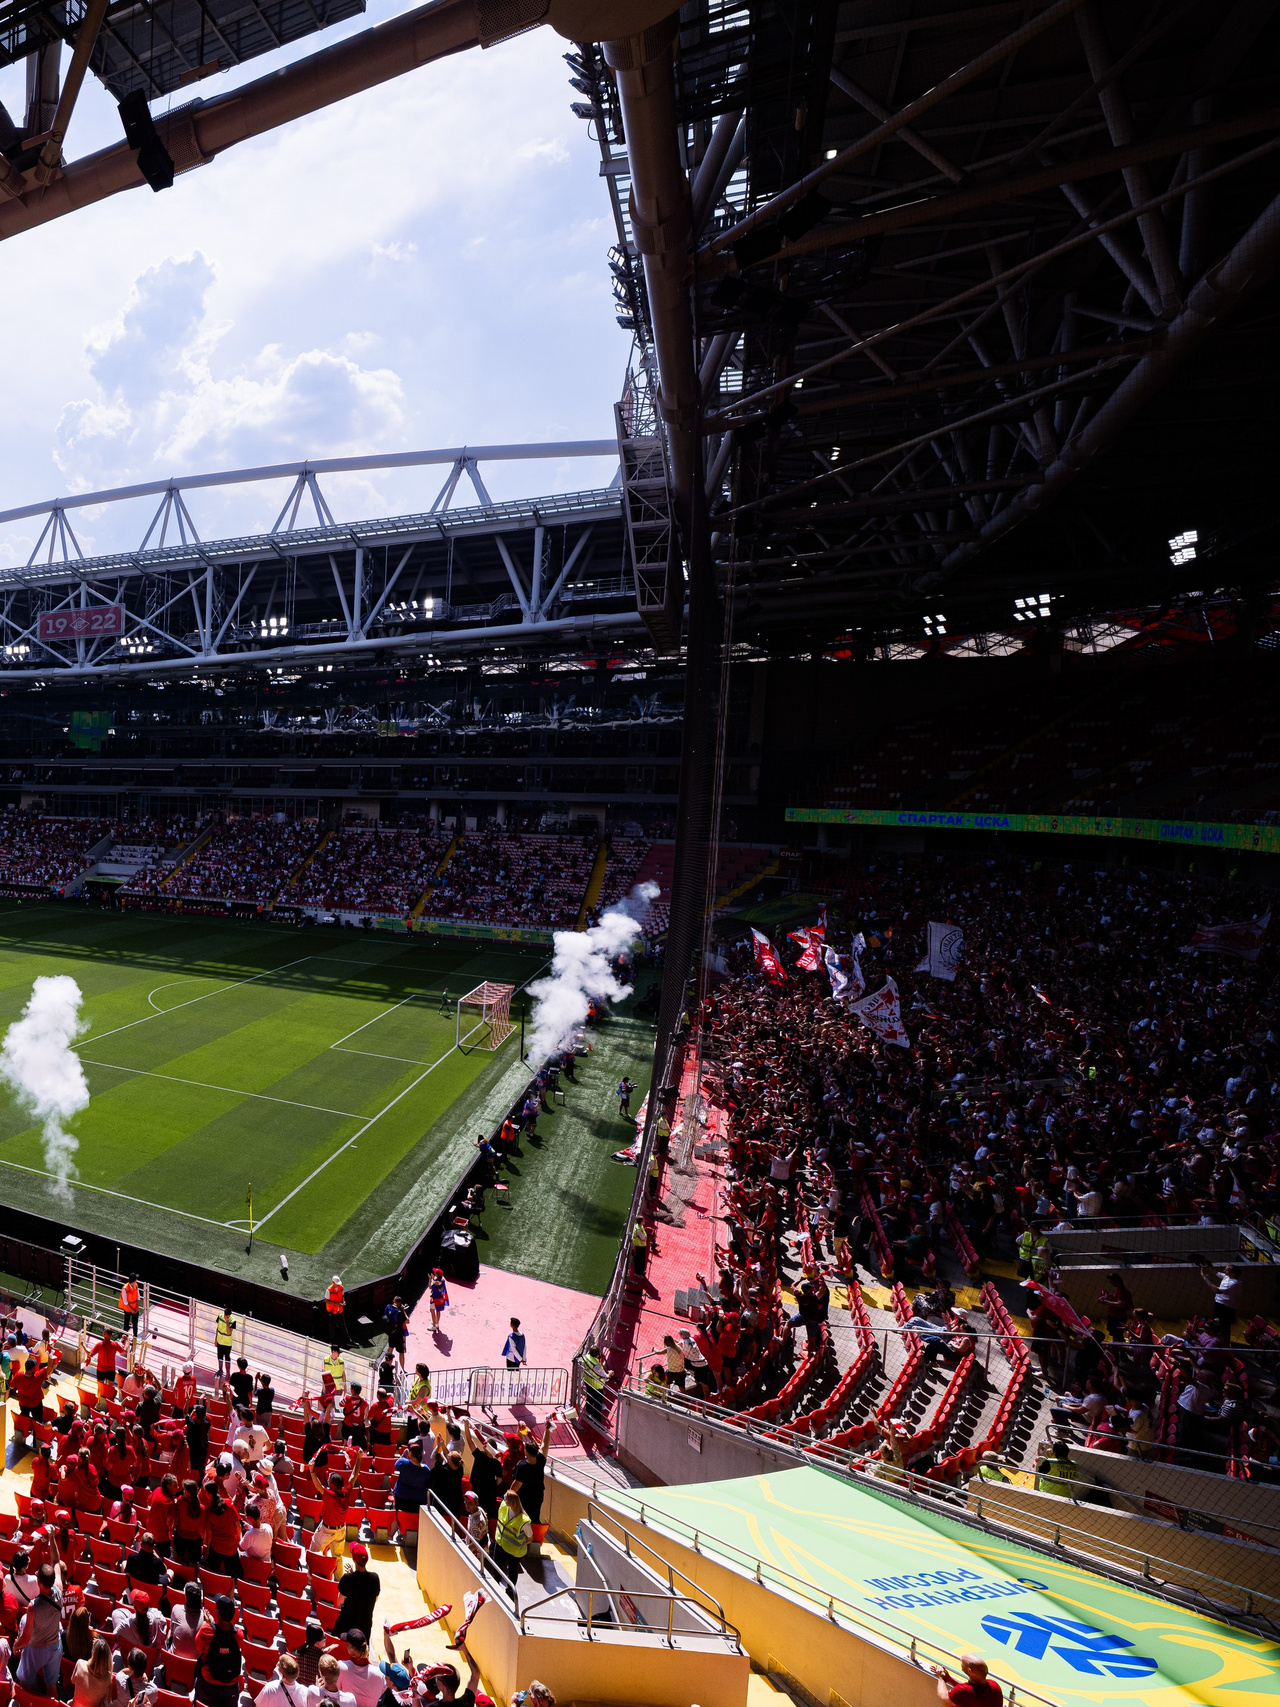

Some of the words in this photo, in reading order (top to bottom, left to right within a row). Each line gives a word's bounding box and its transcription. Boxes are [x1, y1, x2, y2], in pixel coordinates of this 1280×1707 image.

[46, 617, 68, 634] 19
[91, 613, 117, 630] 22
[898, 813, 964, 826] СПАРТАК
[974, 816, 1010, 828] ЦСКА
[1161, 824, 1195, 840] СПАРТАК
[1201, 827, 1225, 843] ЦСКА
[863, 1567, 983, 1591] РОССИИ
[863, 1577, 1049, 1610] СУПЕРКУБОК
